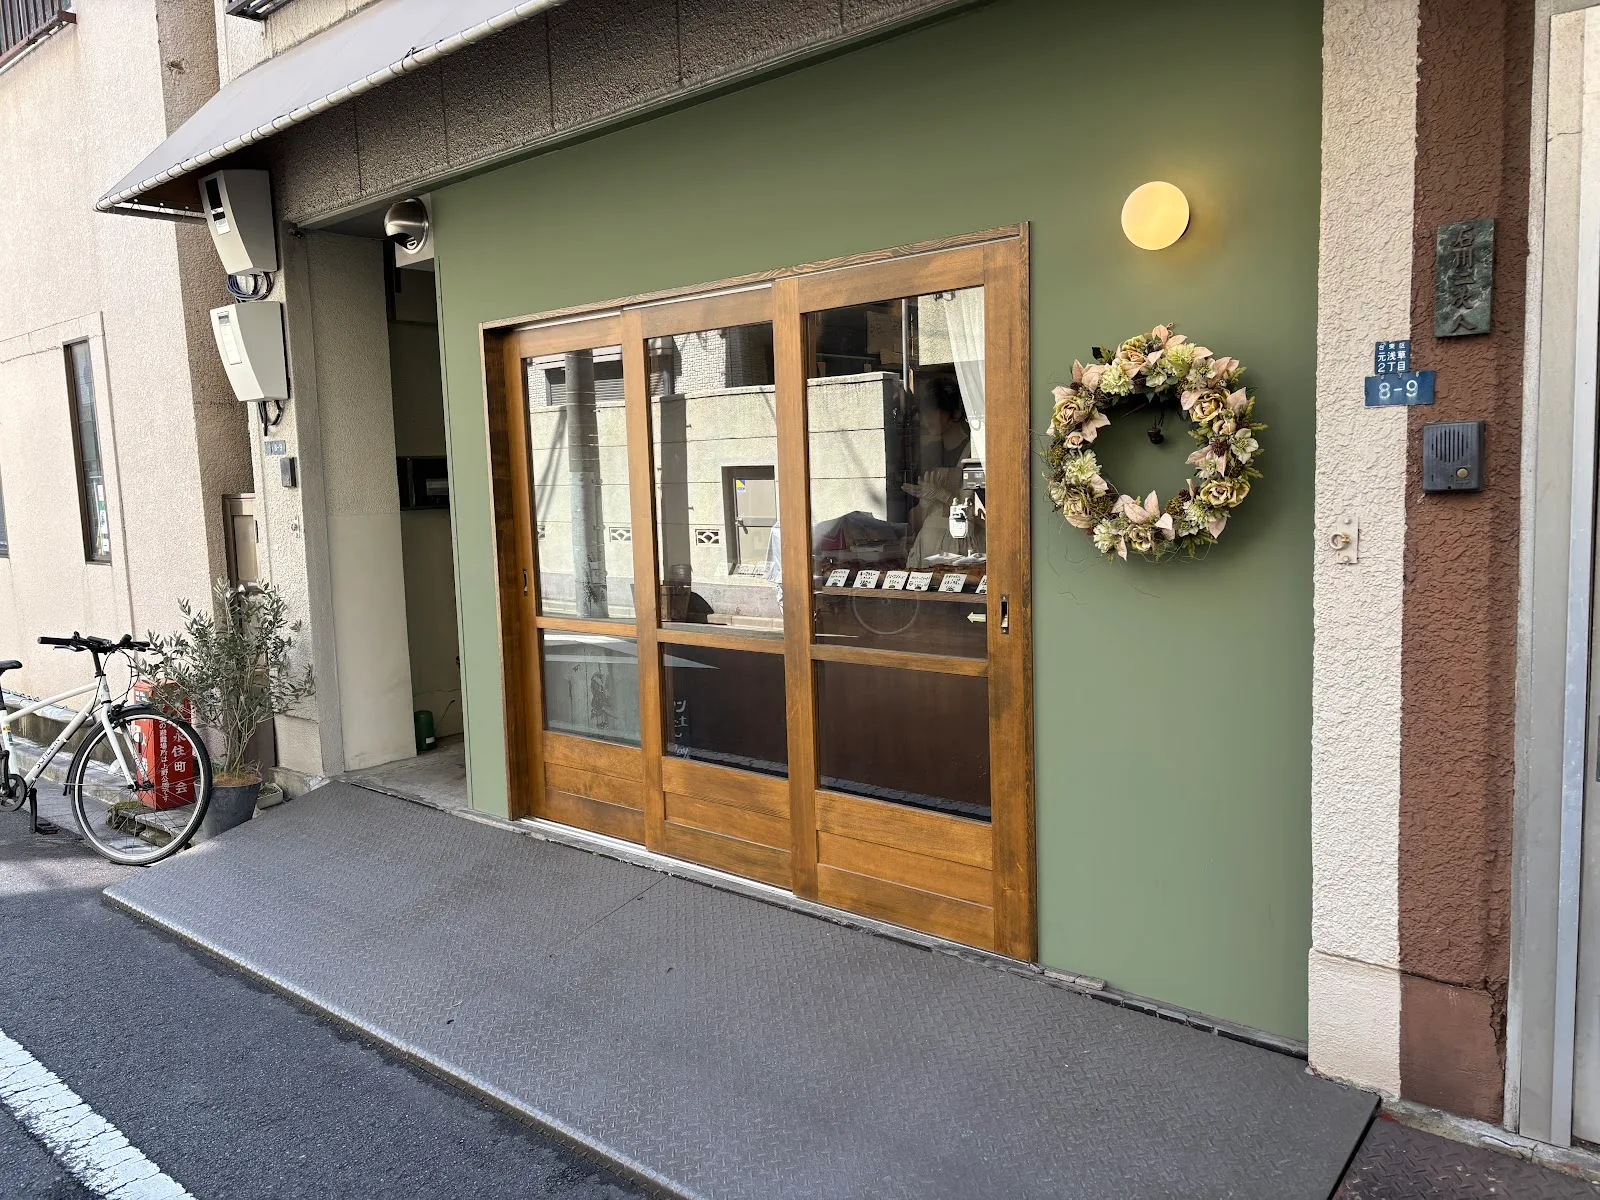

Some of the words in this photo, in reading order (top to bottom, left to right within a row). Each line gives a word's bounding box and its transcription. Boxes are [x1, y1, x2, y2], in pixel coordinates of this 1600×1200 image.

[1379, 342, 1406, 351] 台東区
[1377, 350, 1407, 362] 元浅草
[1377, 361, 1406, 373] 2丁目
[1378, 379, 1419, 399] 8-9
[171, 730, 188, 794] 永住町会
